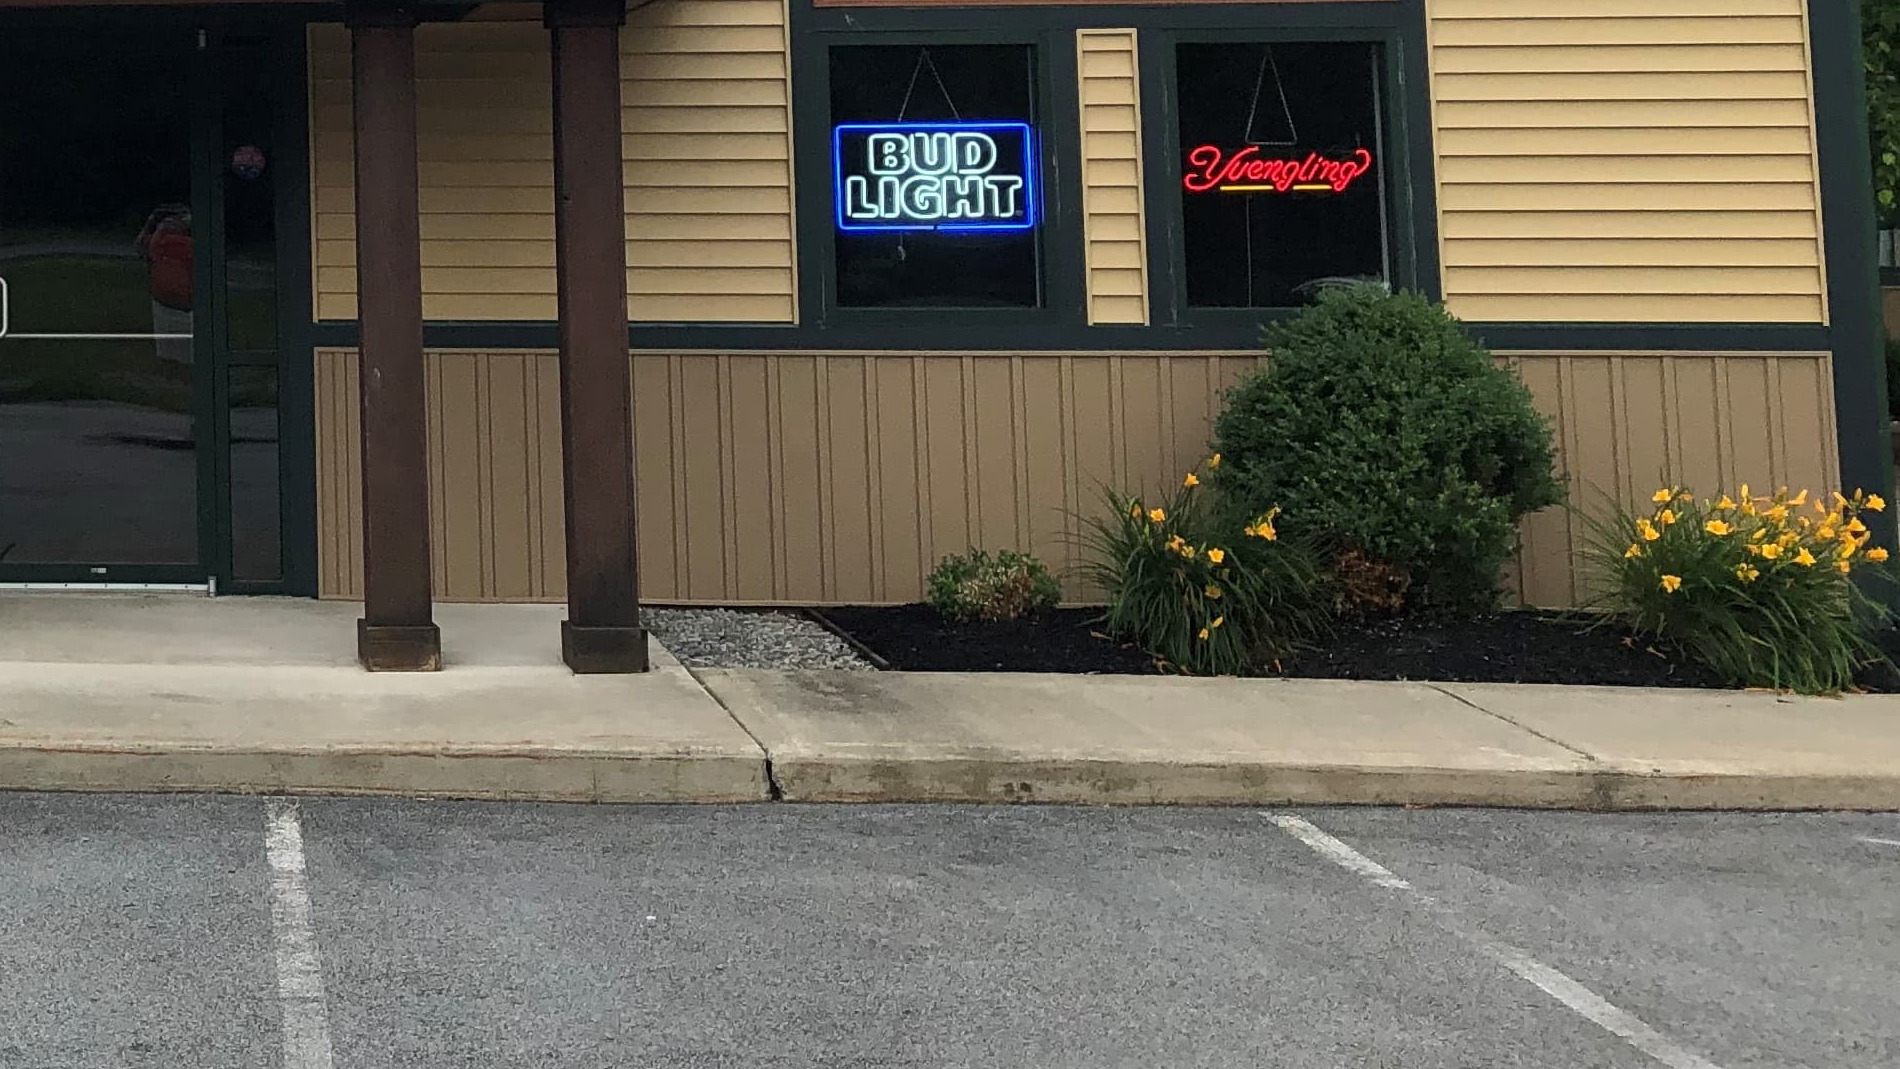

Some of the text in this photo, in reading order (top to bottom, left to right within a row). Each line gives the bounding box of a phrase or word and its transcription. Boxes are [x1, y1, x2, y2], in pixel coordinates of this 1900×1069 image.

[867, 132, 997, 175] BUD
[1184, 145, 1372, 192] Yuengling
[846, 175, 1023, 219] LIGHT
